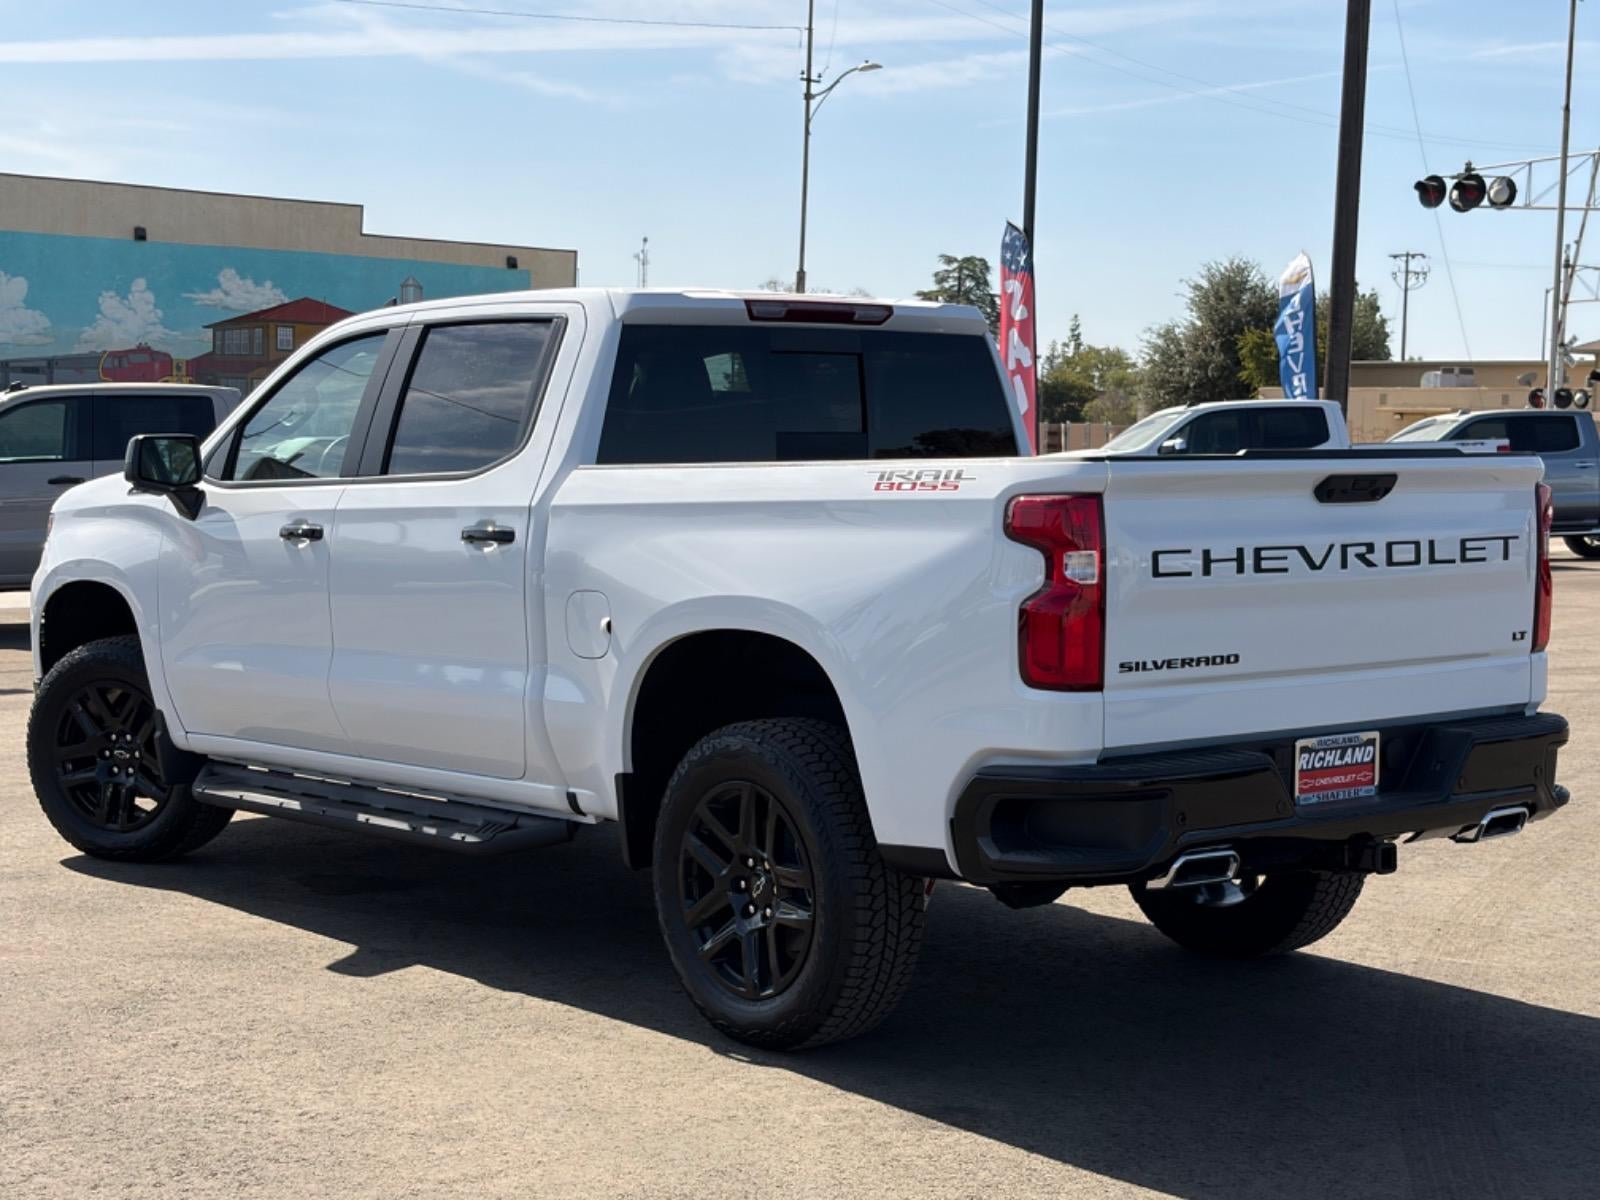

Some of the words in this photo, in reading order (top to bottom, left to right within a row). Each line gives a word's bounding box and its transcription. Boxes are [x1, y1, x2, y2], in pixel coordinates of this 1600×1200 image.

[866, 469, 976, 481] TRAIL
[874, 481, 960, 491] BOSS
[1152, 536, 1519, 578] CHEVROLET
[1512, 630, 1527, 641] LT
[1118, 653, 1240, 673] SILVERADO
[1299, 745, 1374, 770] RICHLAND
[1315, 773, 1357, 786] CHEVROLET
